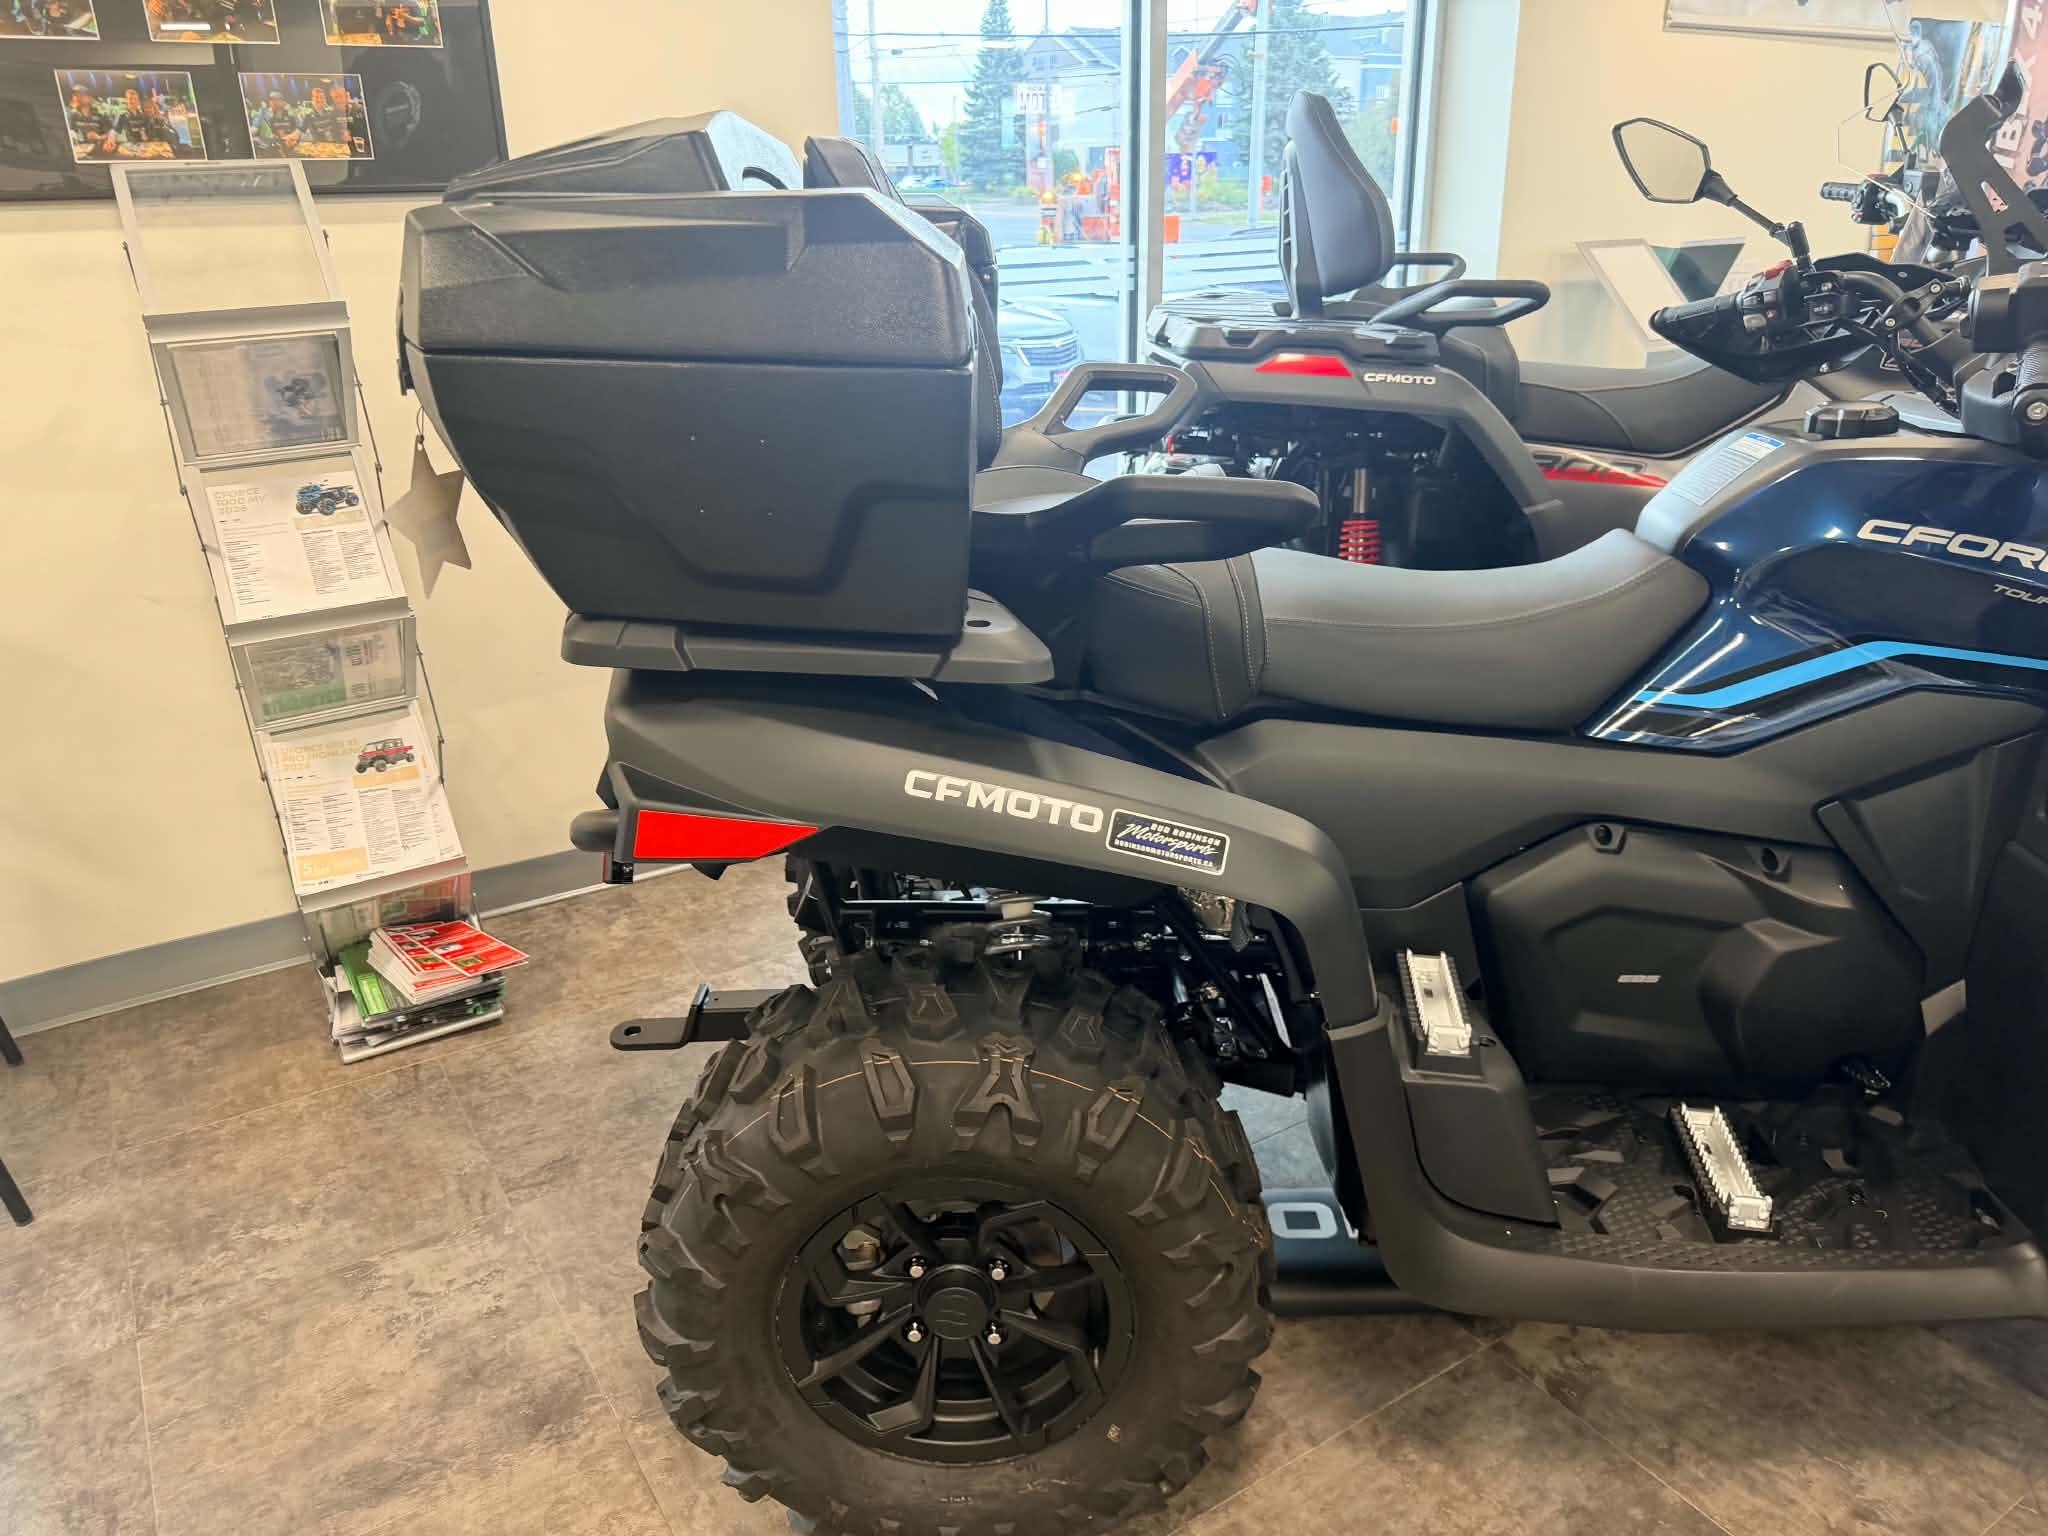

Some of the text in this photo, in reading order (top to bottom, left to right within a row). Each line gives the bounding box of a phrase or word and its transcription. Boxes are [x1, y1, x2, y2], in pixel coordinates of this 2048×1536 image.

[1363, 372, 1436, 385] CFMOTO
[904, 769, 1104, 833] CFMOTO
[1116, 823, 1219, 855] Motorsports
[1172, 829, 1221, 846] ROBINSON
